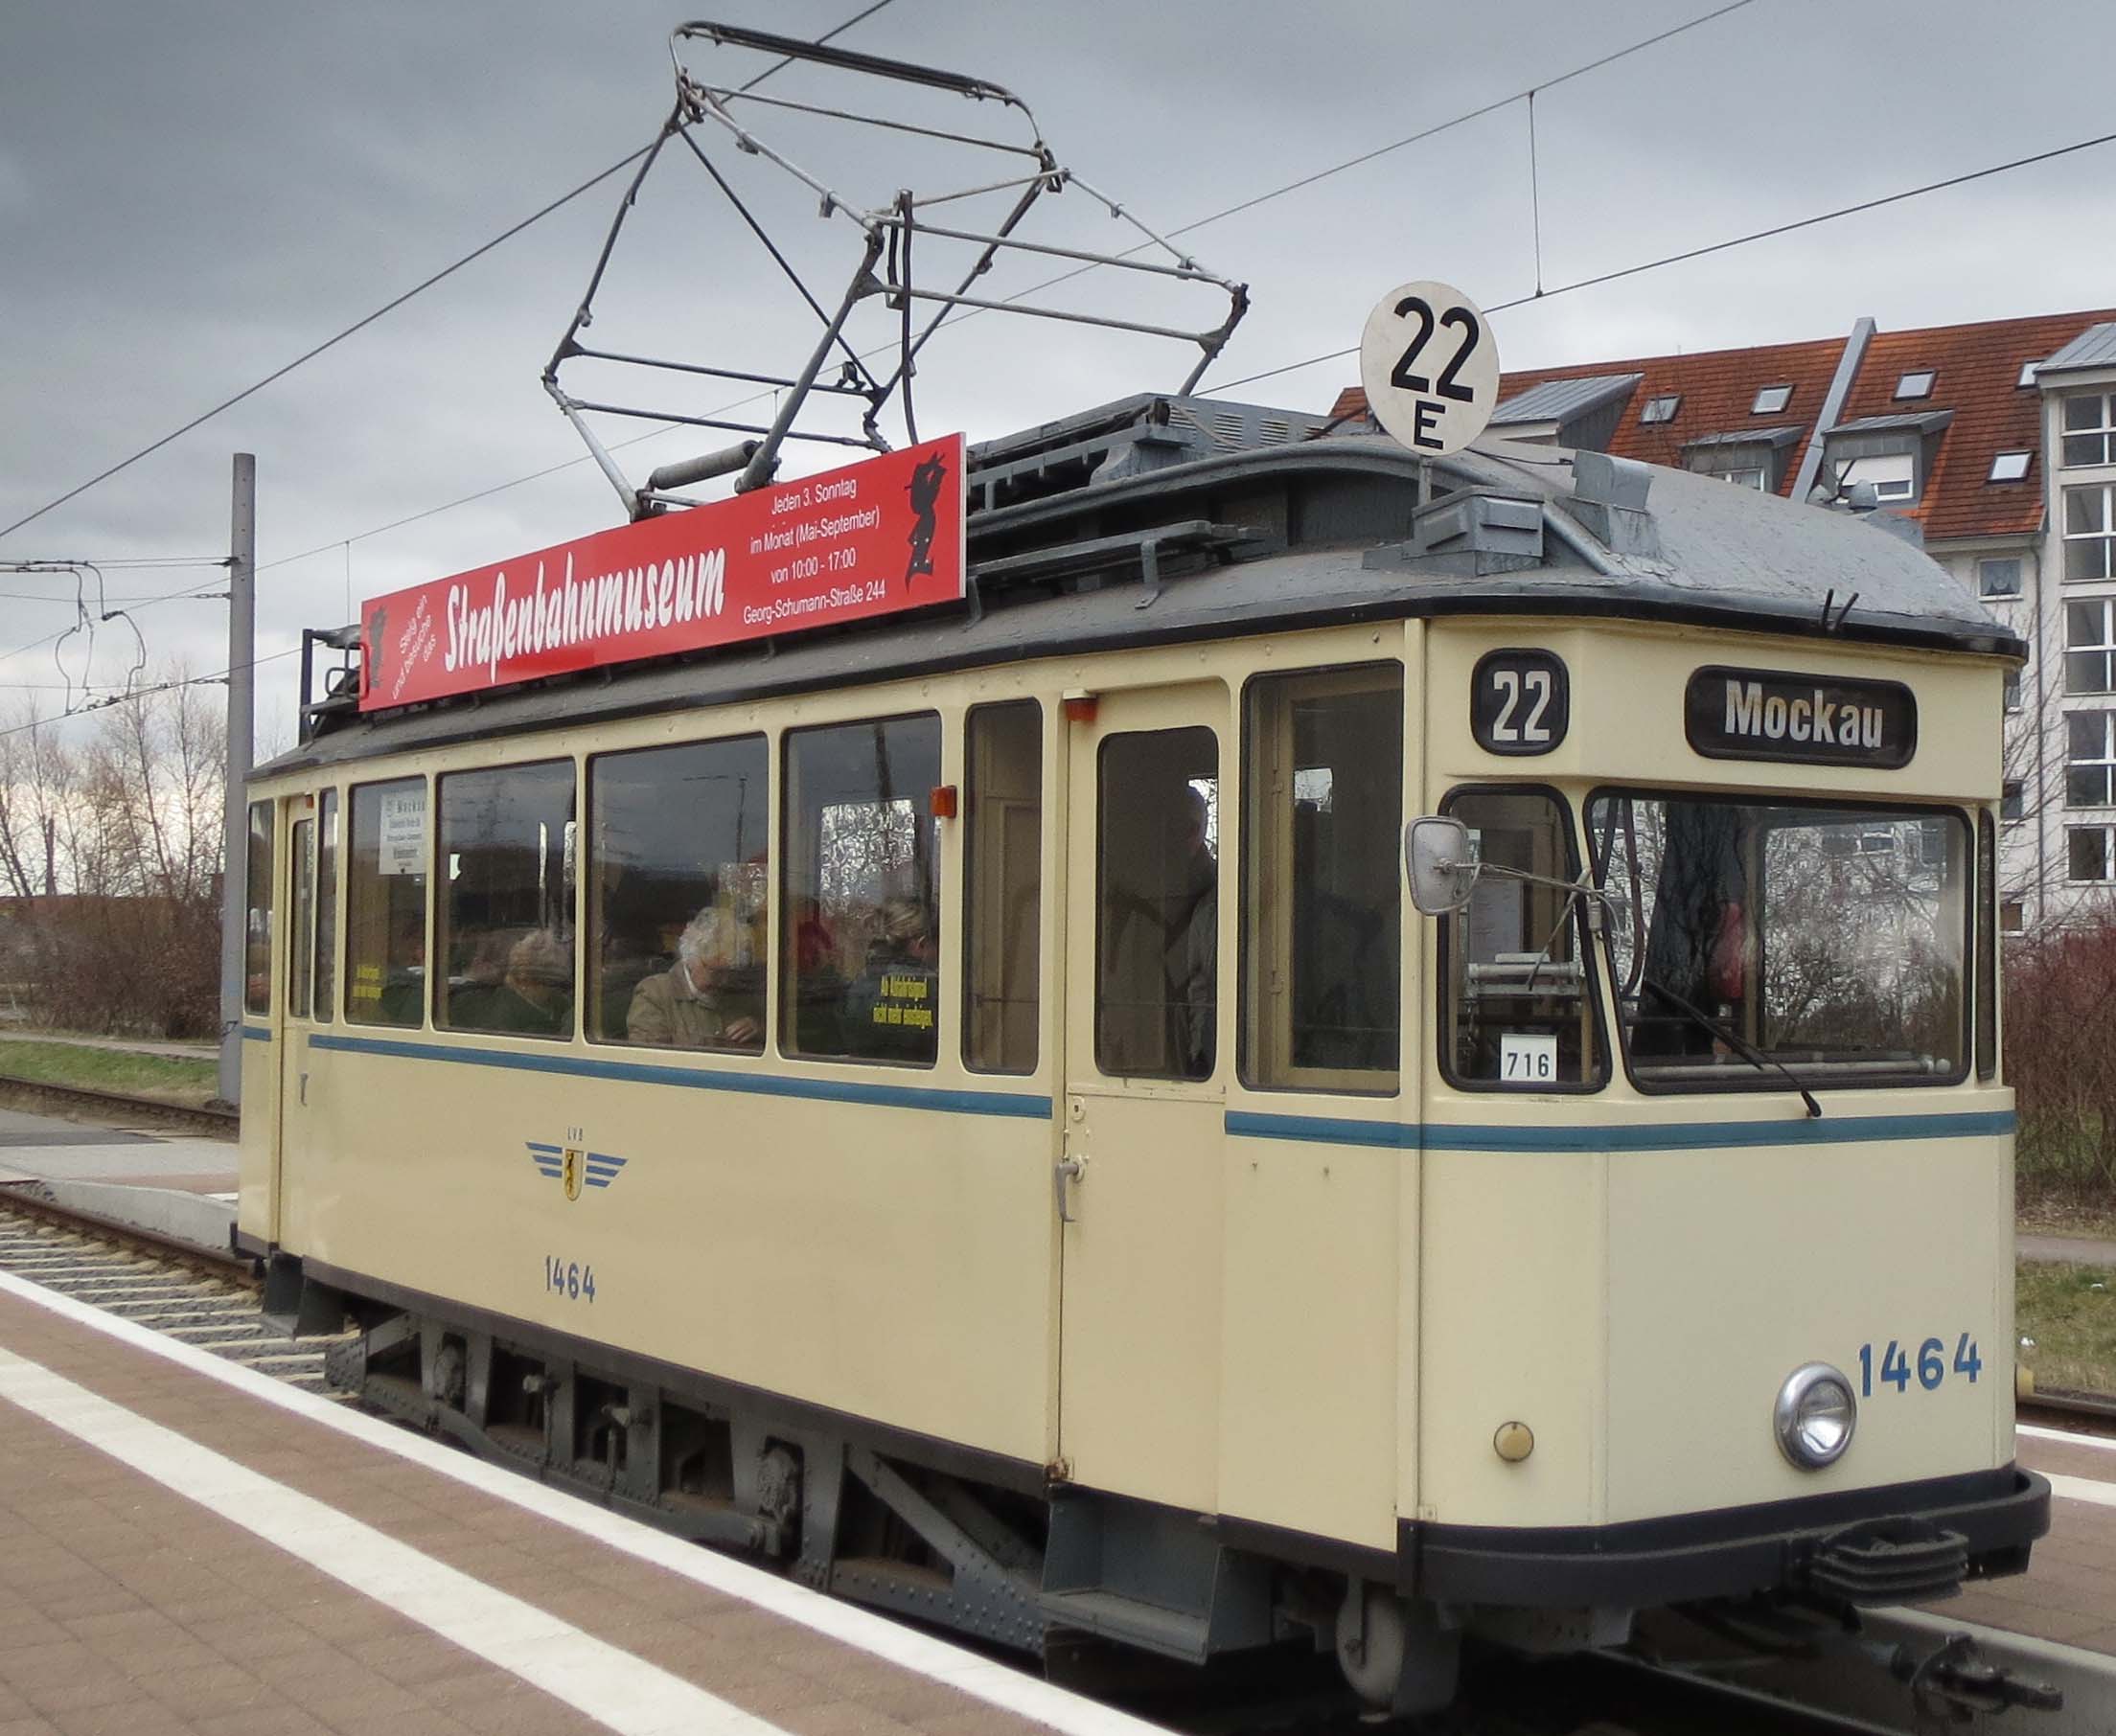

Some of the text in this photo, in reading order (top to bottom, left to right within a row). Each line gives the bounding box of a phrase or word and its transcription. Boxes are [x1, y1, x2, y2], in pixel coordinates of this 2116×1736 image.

[1392, 297, 1479, 402] 22
[1414, 400, 1446, 449] E
[771, 479, 857, 514] Jeden 3. Sonntag
[750, 505, 880, 554] im Monat (Mai-September)
[770, 568, 788, 583] von
[792, 557, 818, 579] 10:00
[828, 547, 856, 571] 17:00
[445, 547, 725, 683] Straßenbahnmuseum
[744, 579, 886, 625] Georg-Schumann-Straße 244
[1493, 671, 1551, 741] 22
[1725, 679, 1883, 748] Mockau
[1507, 1052, 1550, 1078] 716
[546, 1255, 596, 1304] 1464
[1859, 1332, 1983, 1398] 1464
